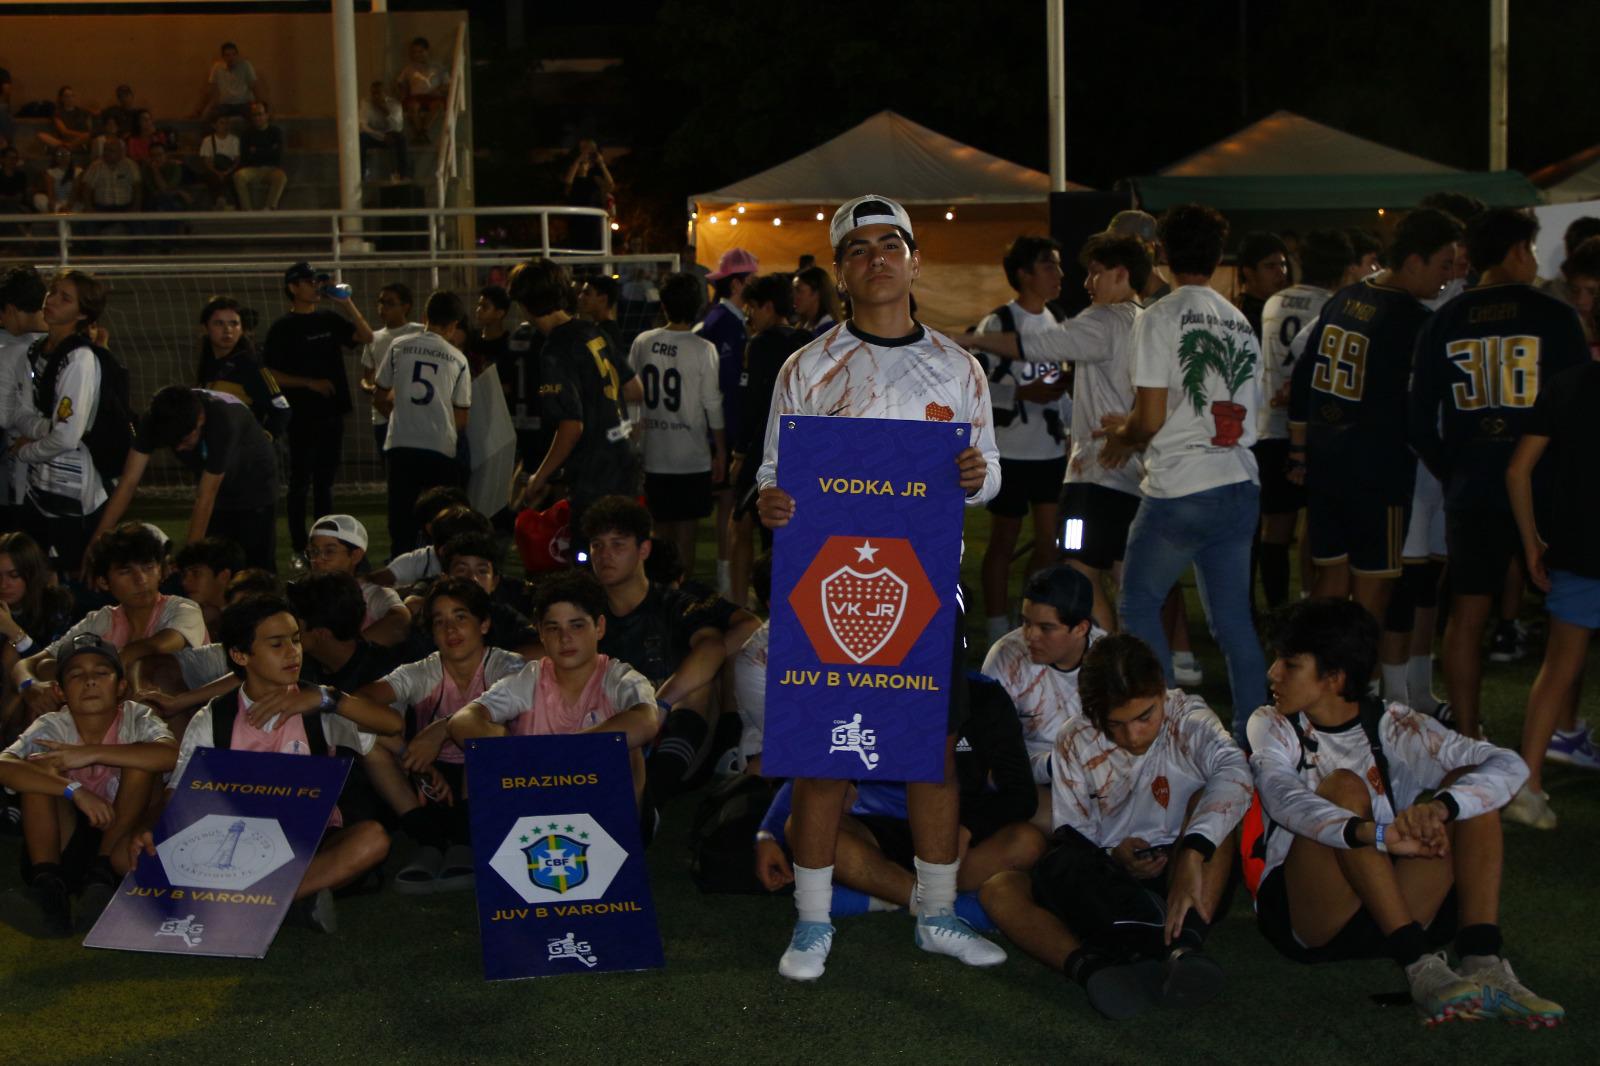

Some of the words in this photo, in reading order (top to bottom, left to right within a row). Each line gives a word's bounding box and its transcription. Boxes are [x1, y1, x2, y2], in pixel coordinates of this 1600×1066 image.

[652, 342, 678, 357] CRIS
[1022, 361, 1061, 380] Jee
[1311, 324, 1370, 402] 99
[1445, 334, 1542, 411] 318
[411, 361, 438, 405] 5
[642, 364, 681, 412] 09
[818, 477, 895, 496] VODKA
[900, 481, 927, 497] JR
[831, 601, 862, 616] VK
[866, 603, 895, 618] JR
[779, 670, 821, 686] JUV
[826, 671, 841, 687] B
[847, 672, 940, 691] VARONIL
[831, 728, 876, 746] GSG
[190, 780, 292, 796] SANTORINI
[297, 787, 322, 799] FC
[501, 773, 599, 790] BRAZINOS
[544, 858, 570, 867] CBF
[126, 887, 167, 899] JUV
[170, 890, 184, 900] B
[191, 890, 278, 906] VARONIL
[491, 908, 529, 921] JUV
[535, 906, 549, 918] B
[554, 900, 643, 918] VARONIL
[548, 940, 592, 955] GSG
